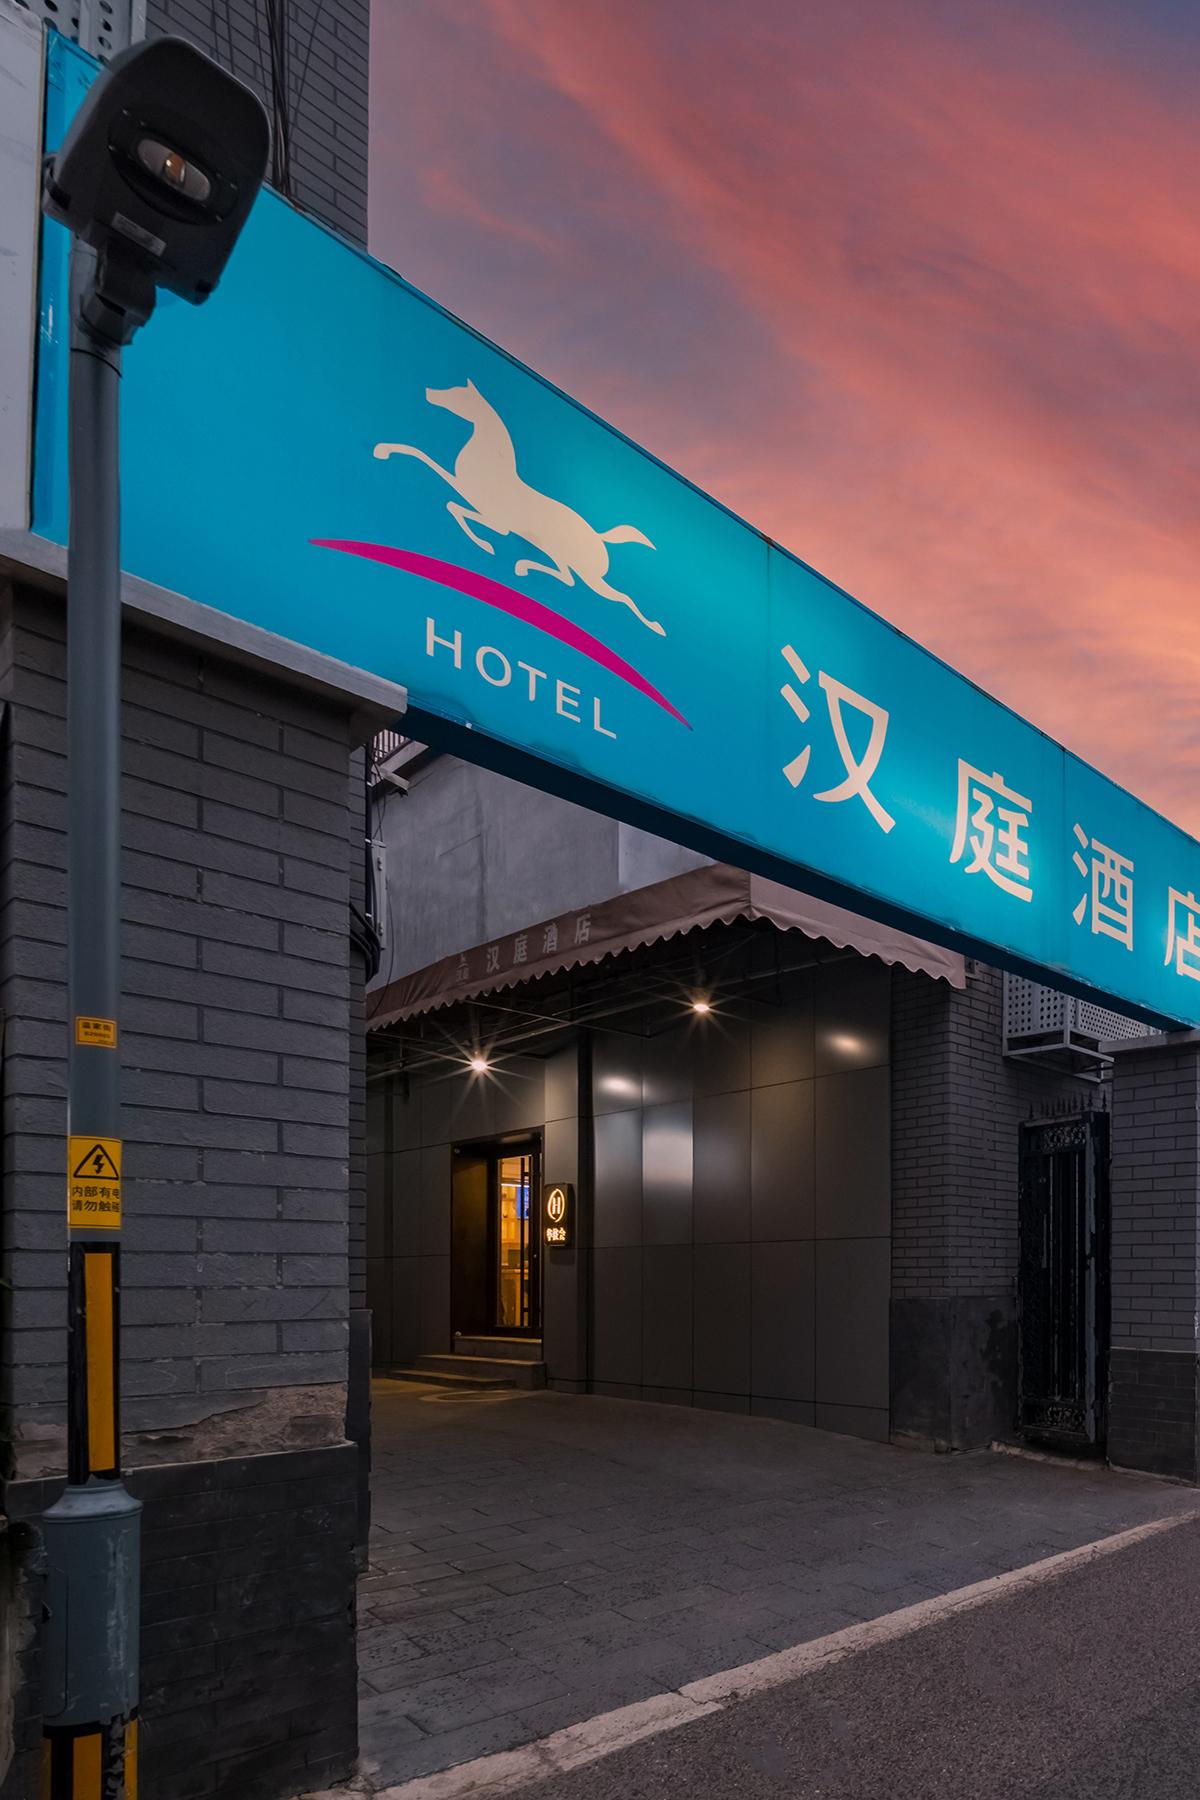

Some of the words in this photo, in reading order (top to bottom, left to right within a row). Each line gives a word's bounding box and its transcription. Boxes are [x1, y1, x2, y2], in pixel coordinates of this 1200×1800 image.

[425, 616, 617, 740] HOTEL
[486, 913, 592, 974] 汉庭酒店
